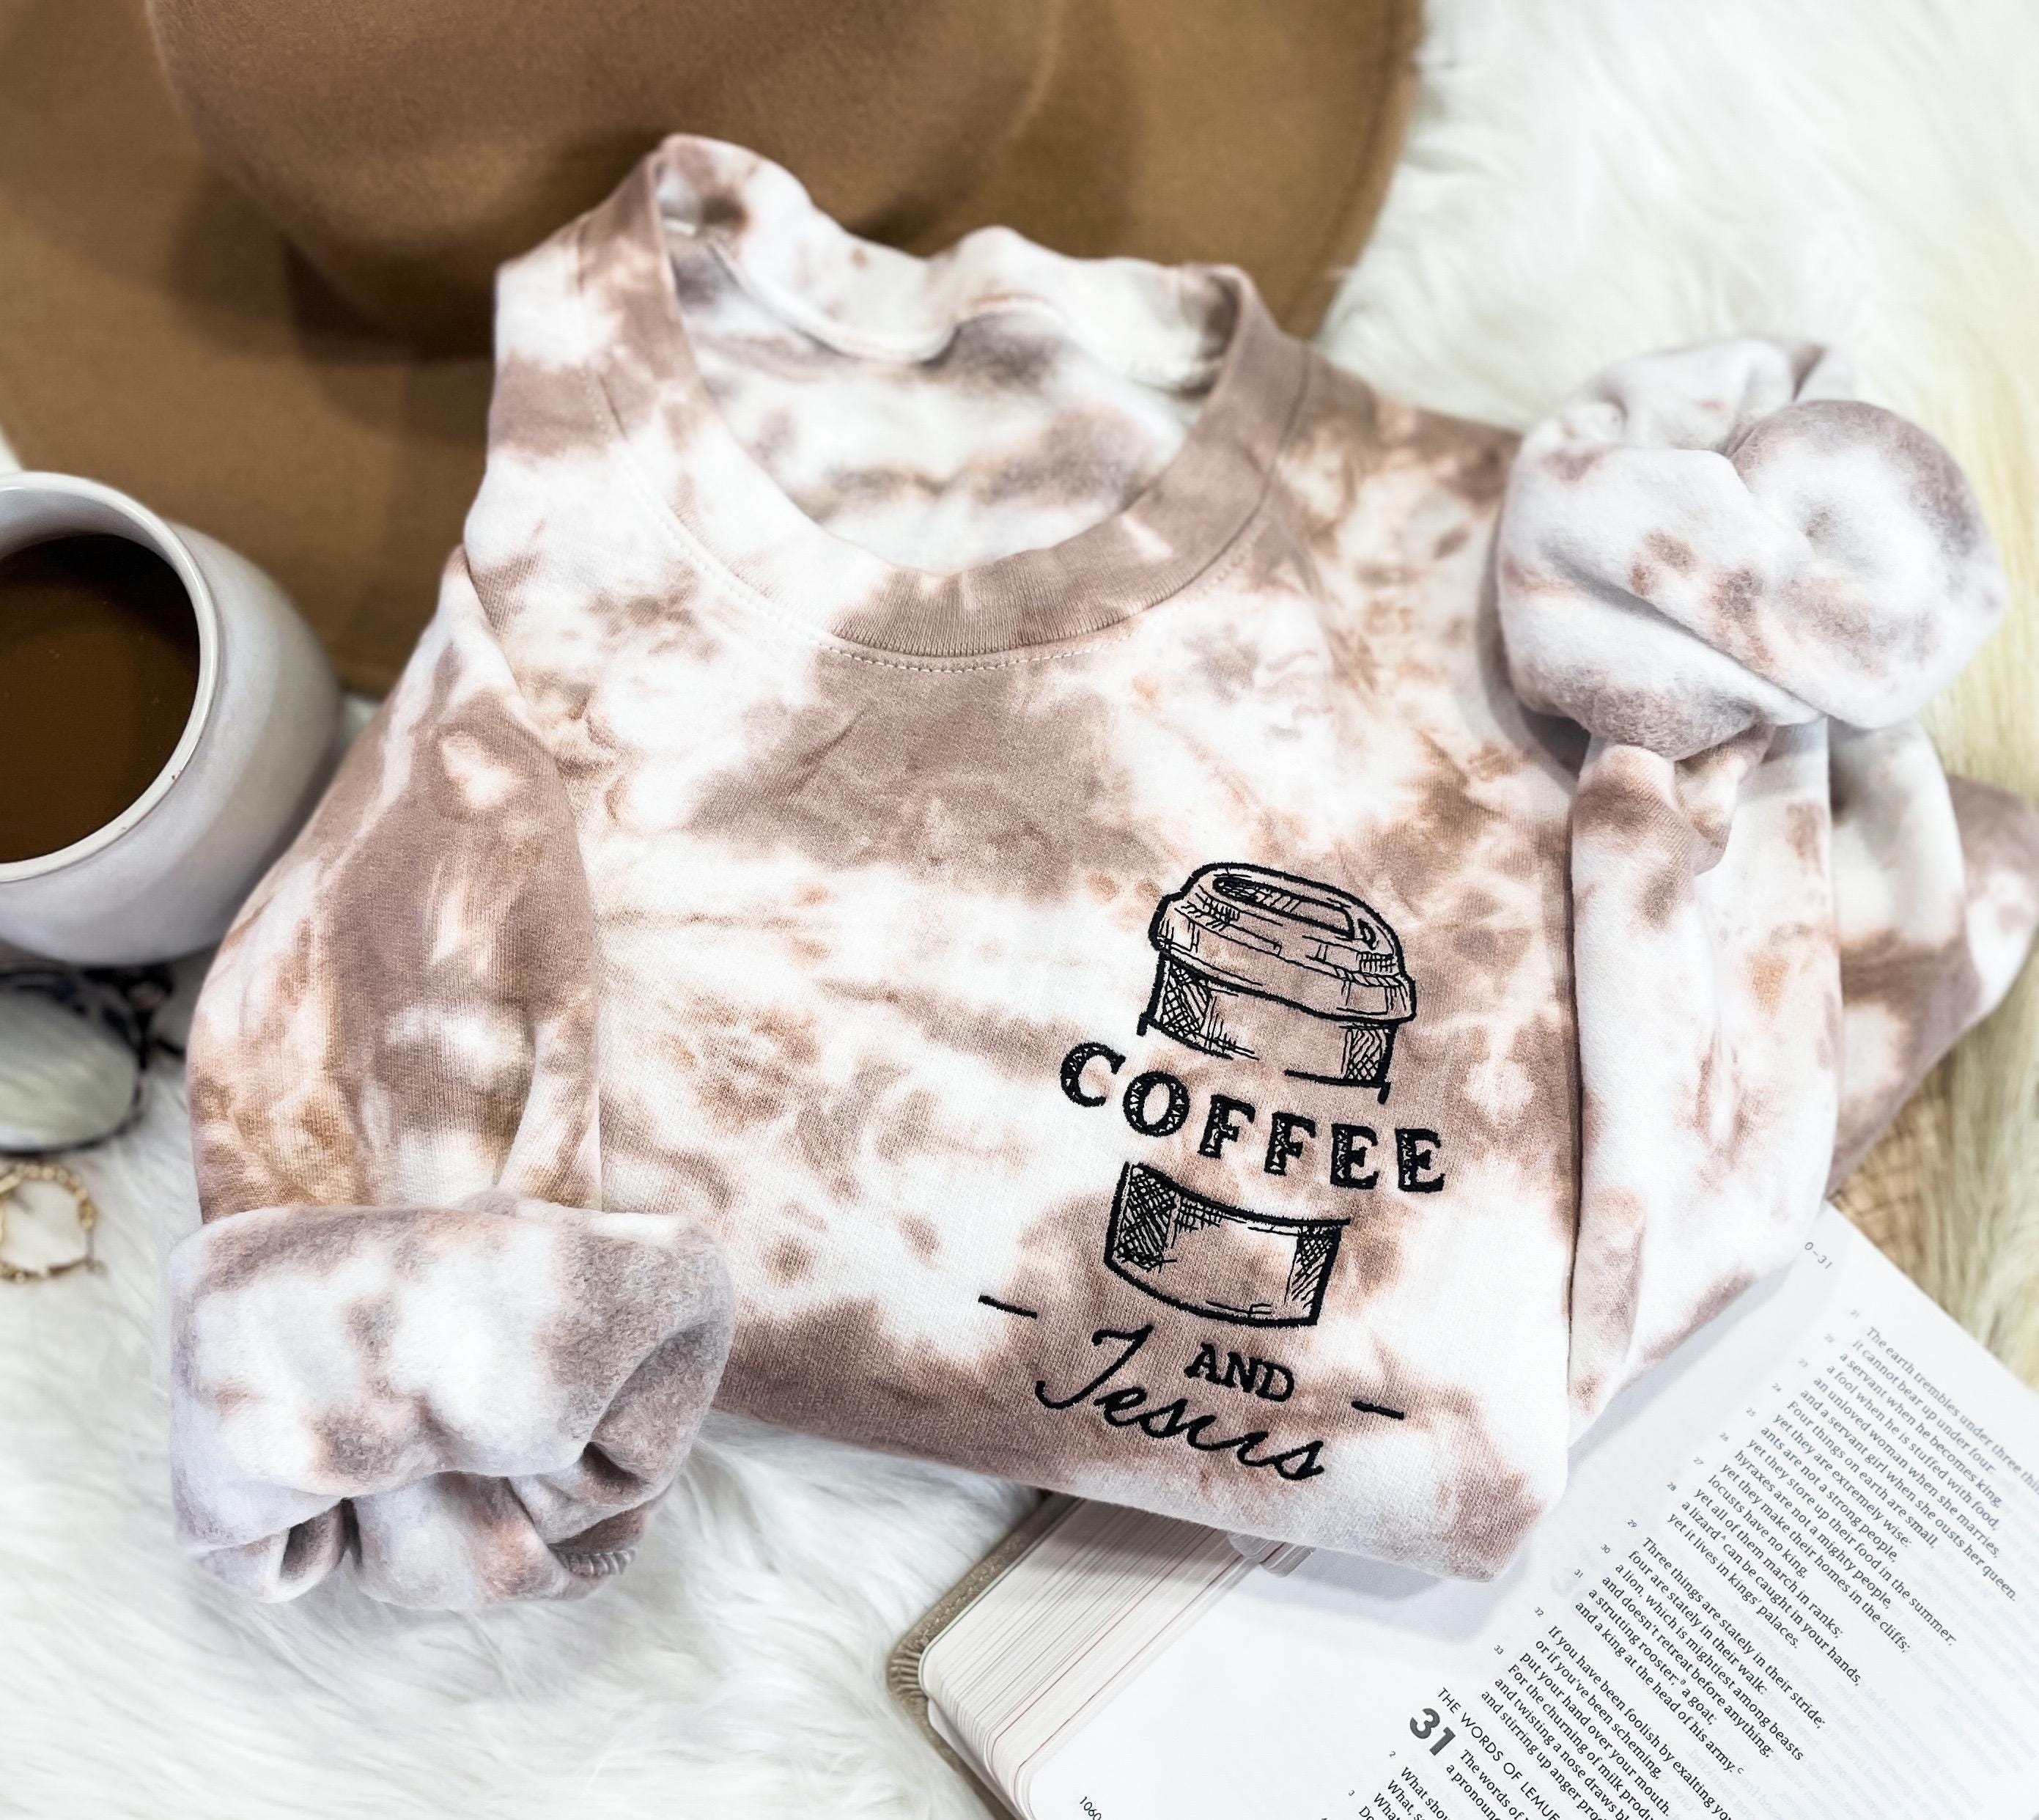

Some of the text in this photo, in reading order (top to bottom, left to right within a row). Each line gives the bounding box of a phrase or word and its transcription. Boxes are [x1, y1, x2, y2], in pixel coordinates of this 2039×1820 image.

[1060, 1041, 1446, 1193] COFFEE
[1034, 1323, 1324, 1481] Jesus
[1184, 1343, 1296, 1402] AND
[1708, 1474, 1745, 1513] locusts
[1742, 1508, 1769, 1538] have
[1734, 1449, 1776, 1492] hyraxes
[1773, 1490, 1793, 1510] are
[1791, 1507, 1812, 1528] not
[1816, 1533, 1857, 1572] mighty
[1760, 1427, 1785, 1451] ants
[1782, 1448, 1802, 1467] are
[1799, 1465, 1821, 1486] not
[1826, 1491, 1863, 1528] strong
[1772, 1414, 1793, 1433] yet
[1791, 1429, 1816, 1455] they
[1813, 1453, 1833, 1472] are
[1831, 1470, 1885, 1521] extremely
[1786, 1400, 1815, 1427] Four
[1812, 1425, 1846, 1459] things
[1859, 1471, 1889, 1501] earth
[1887, 1498, 1907, 1517] are
[1693, 1488, 1714, 1508] yet
[1711, 1505, 1728, 1521] all
[1736, 1530, 1765, 1561] them
[1762, 1557, 1798, 1594] march
[1719, 1464, 1740, 1482] yet
[1738, 1479, 1763, 1505] they
[1759, 1503, 1791, 1533] make
[1788, 1530, 1818, 1558] their
[1813, 1554, 1851, 1593] homes
[1861, 1602, 1881, 1624] the
[1746, 1439, 1766, 1458] yet
[1764, 1454, 1790, 1480] they
[1786, 1478, 1815, 1506] store
[1828, 1517, 1857, 1545] their
[1853, 1542, 1883, 1570] food
[1890, 1579, 1911, 1599] the
[1595, 1596, 1641, 1646] strutting
[1627, 1550, 1653, 1576] four
[1650, 1574, 1670, 1594] are
[1667, 1591, 1703, 1627] stately
[1711, 1637, 1740, 1665] their
[1642, 1536, 1673, 1570] Three
[1670, 1567, 1704, 1603] things
[1701, 1601, 1721, 1621] are
[1719, 1618, 1756, 1655] stately
[1764, 1665, 1793, 1693] their
[1667, 1513, 1687, 1533] yet
[1692, 1536, 1719, 1565] lives
[1755, 1605, 1799, 1649] palaces.
[1722, 1544, 1743, 1565] can
[1755, 1576, 1793, 1614] caught
[1800, 1622, 1830, 1651] your
[1574, 1602, 1599, 1625] and
[1601, 1628, 1627, 1658] king
[1634, 1665, 1654, 1686] the
[1651, 1681, 1681, 1713] head
[1688, 1720, 1708, 1742] his
[1601, 1577, 1626, 1599] and
[1656, 1634, 1694, 1673] retreat
[1690, 1667, 1726, 1707] before
[1645, 1594, 1678, 1630] which
[1684, 1637, 1736, 1690] mightiest
[1733, 1687, 1771, 1728] among
[1768, 1722, 1804, 1761] beasts
[1409, 1707, 1457, 1757] 31
[1437, 1687, 1462, 1714] THE
[1460, 1712, 1505, 1762] WORDS
[1502, 1761, 1524, 1780] OF
[1481, 1691, 1505, 1714] and
[1500, 1712, 1539, 1755] stirring
[1549, 1767, 1582, 1801] anger
[1494, 1678, 1618, 1813] and twisting nose draws
[1507, 1663, 1529, 1686] For
[1525, 1684, 1545, 1705] the
[1542, 1703, 1589, 1755] churning
[1596, 1764, 1624, 1792] milk
[1519, 1651, 1670, 1817] put your hand over your mouth.
[1555, 1635, 1579, 1659] you
[1575, 1655, 1602, 1685] have
[1599, 1679, 1626, 1712] been
[1623, 1707, 1661, 1749] foolish
[1672, 1761, 1717, 1808] exalting
[1587, 1693, 1613, 1725] been
[1401, 1766, 1428, 1800] What
[1459, 1749, 1511, 1808] The words
